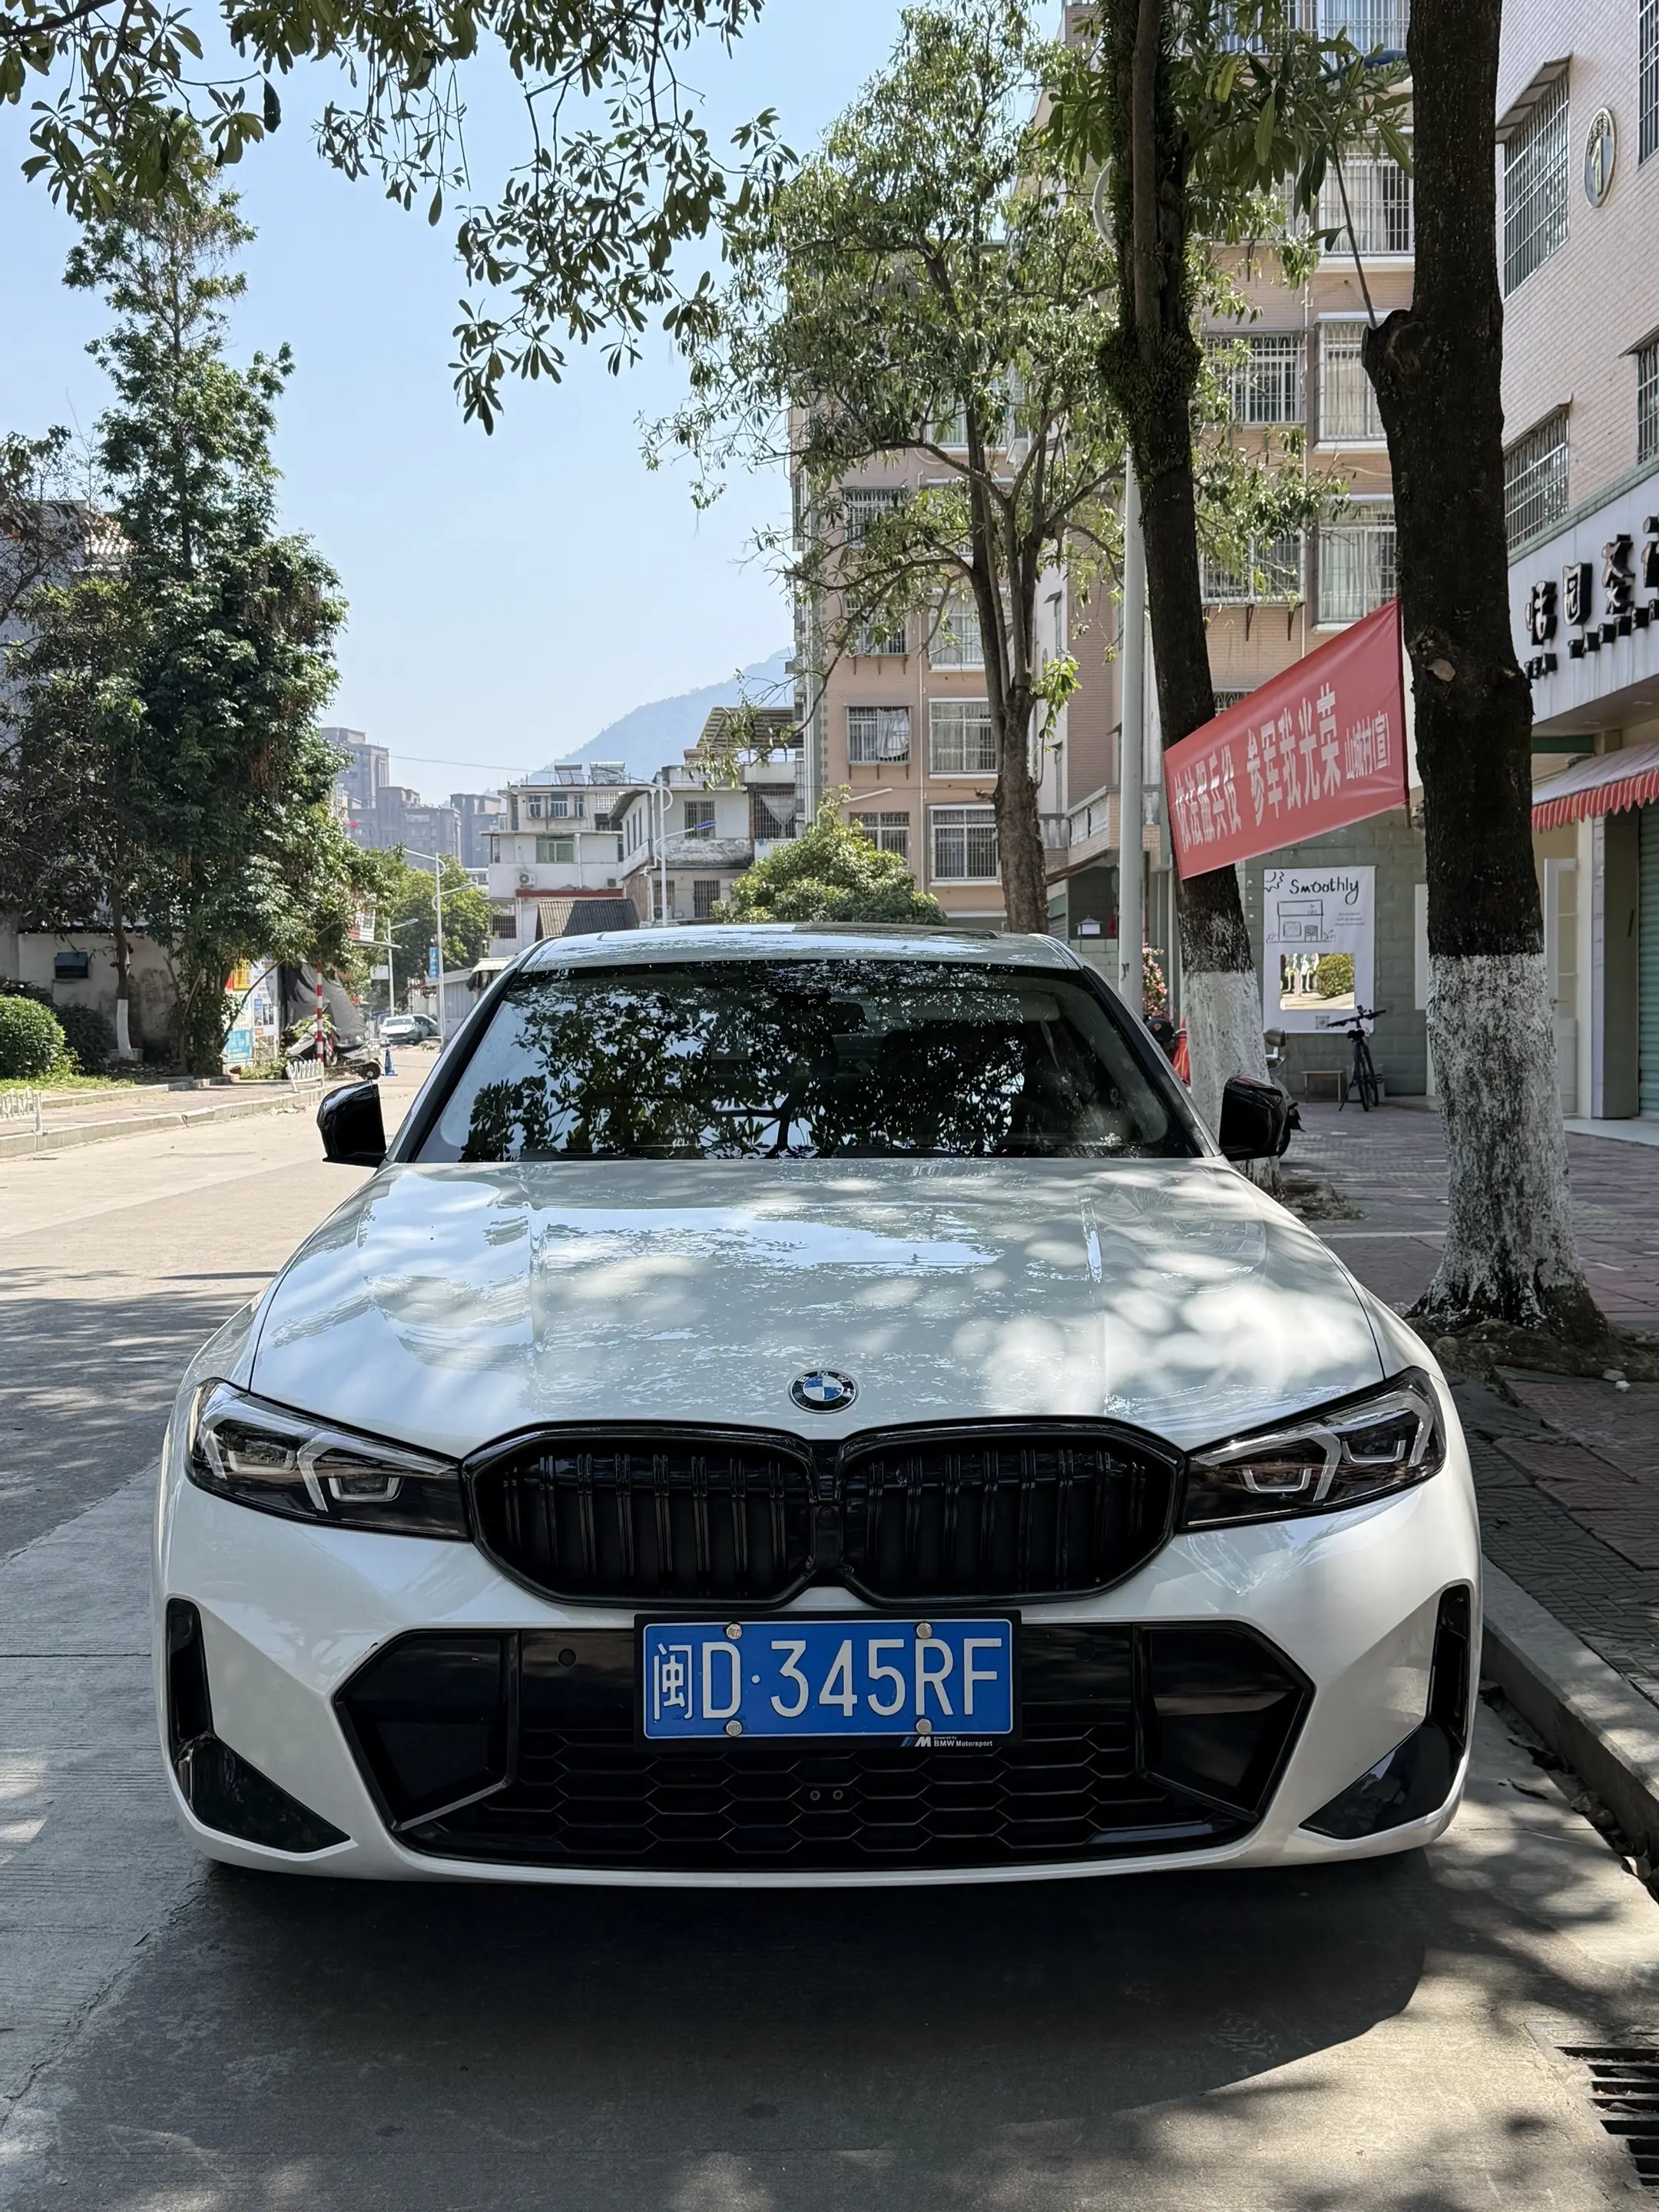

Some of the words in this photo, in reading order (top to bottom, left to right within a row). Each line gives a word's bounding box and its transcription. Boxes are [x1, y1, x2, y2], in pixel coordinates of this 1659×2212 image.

[1247, 682, 1341, 826] 参军我光荣
[1289, 876, 1359, 906] Smoothly
[653, 1637, 1003, 1721] 闽D·345RF
